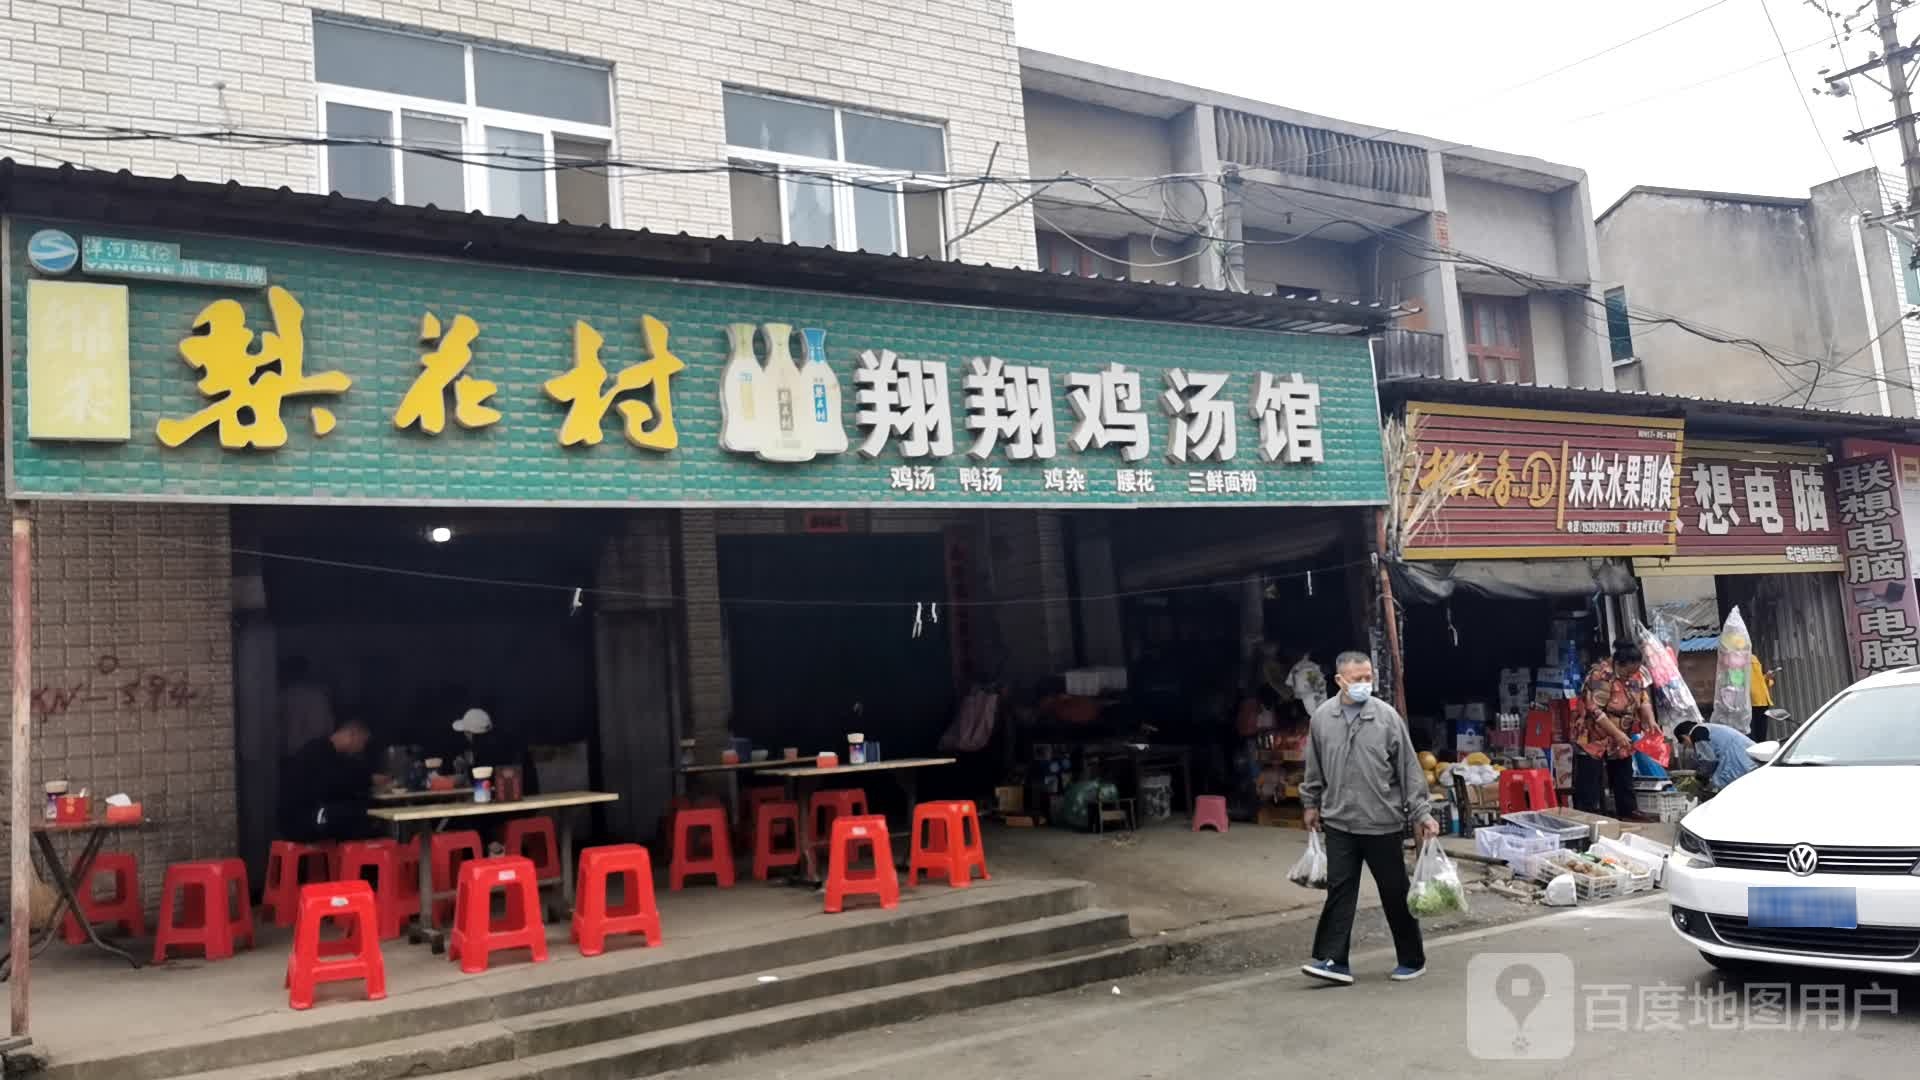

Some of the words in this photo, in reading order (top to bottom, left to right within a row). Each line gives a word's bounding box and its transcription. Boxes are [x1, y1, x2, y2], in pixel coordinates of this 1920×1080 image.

[85, 239, 171, 261] 洋河股份
[181, 259, 267, 284] 旗下品牌
[856, 349, 1324, 463] 翔翔鸡汤馆
[891, 466, 936, 492] 鸡汤
[959, 467, 1003, 493] 鸭汤
[1044, 469, 1086, 492] 鸡杂
[1116, 469, 1155, 493] 腰花
[1188, 470, 1257, 494] 三鲜面粉
[1568, 452, 1675, 508] 米米水果副食
[1677, 463, 1829, 535] 想电脑
[1834, 459, 1907, 585] 联想电脑
